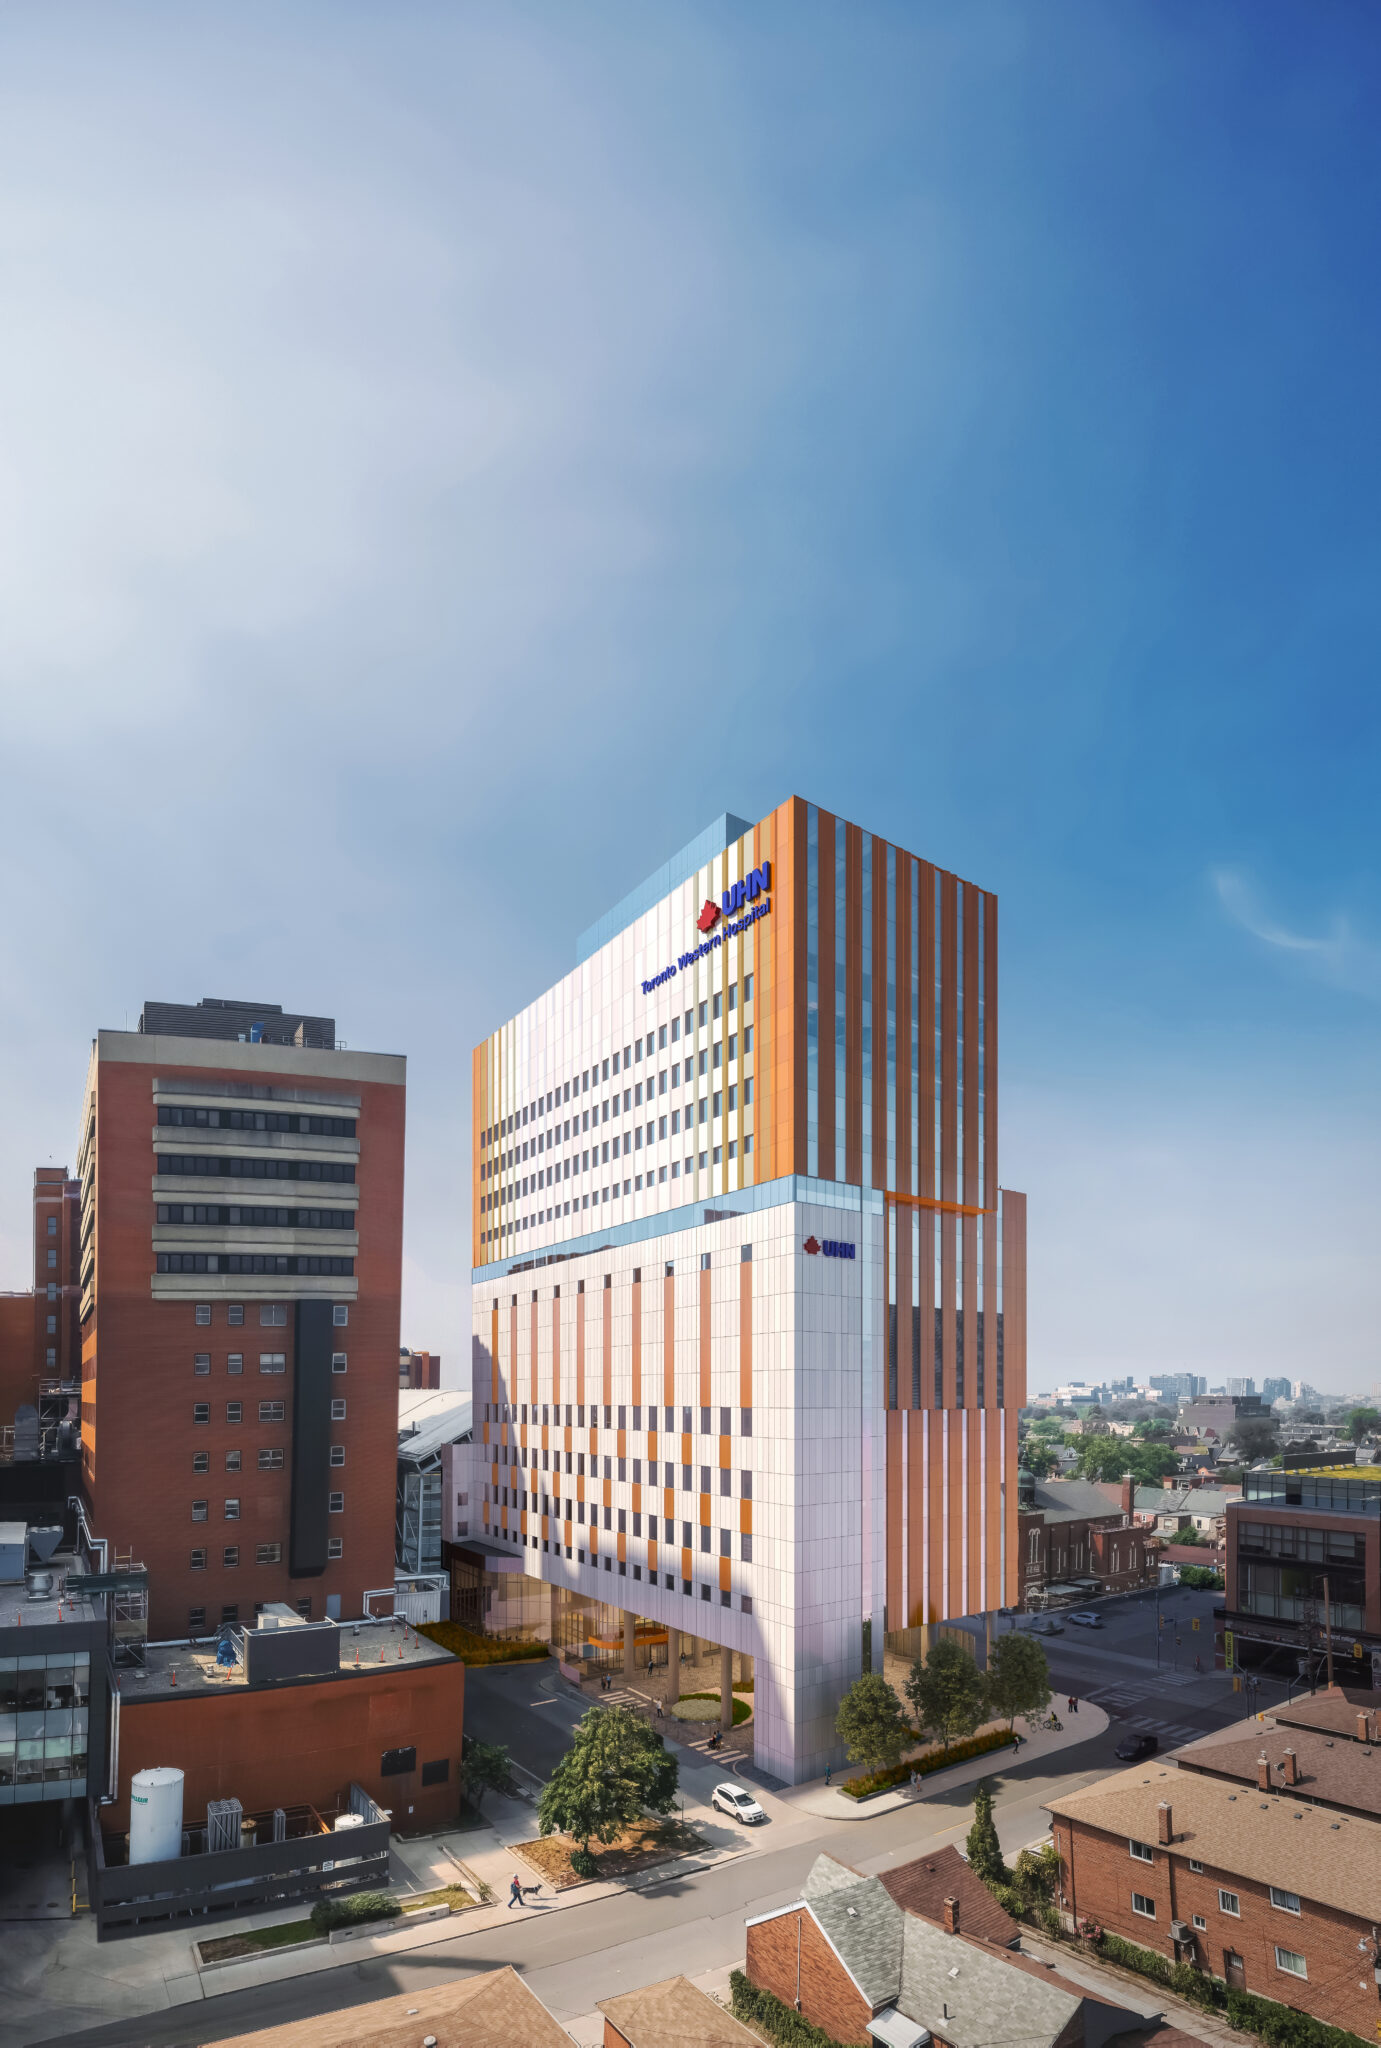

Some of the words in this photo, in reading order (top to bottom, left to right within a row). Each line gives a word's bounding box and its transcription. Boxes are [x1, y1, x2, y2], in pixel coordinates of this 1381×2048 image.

[723, 861, 770, 916] UHN
[641, 965, 677, 995] Toronto
[678, 934, 722, 970] Western
[723, 898, 770, 941] Hospital
[823, 1240, 856, 1260] UHN
